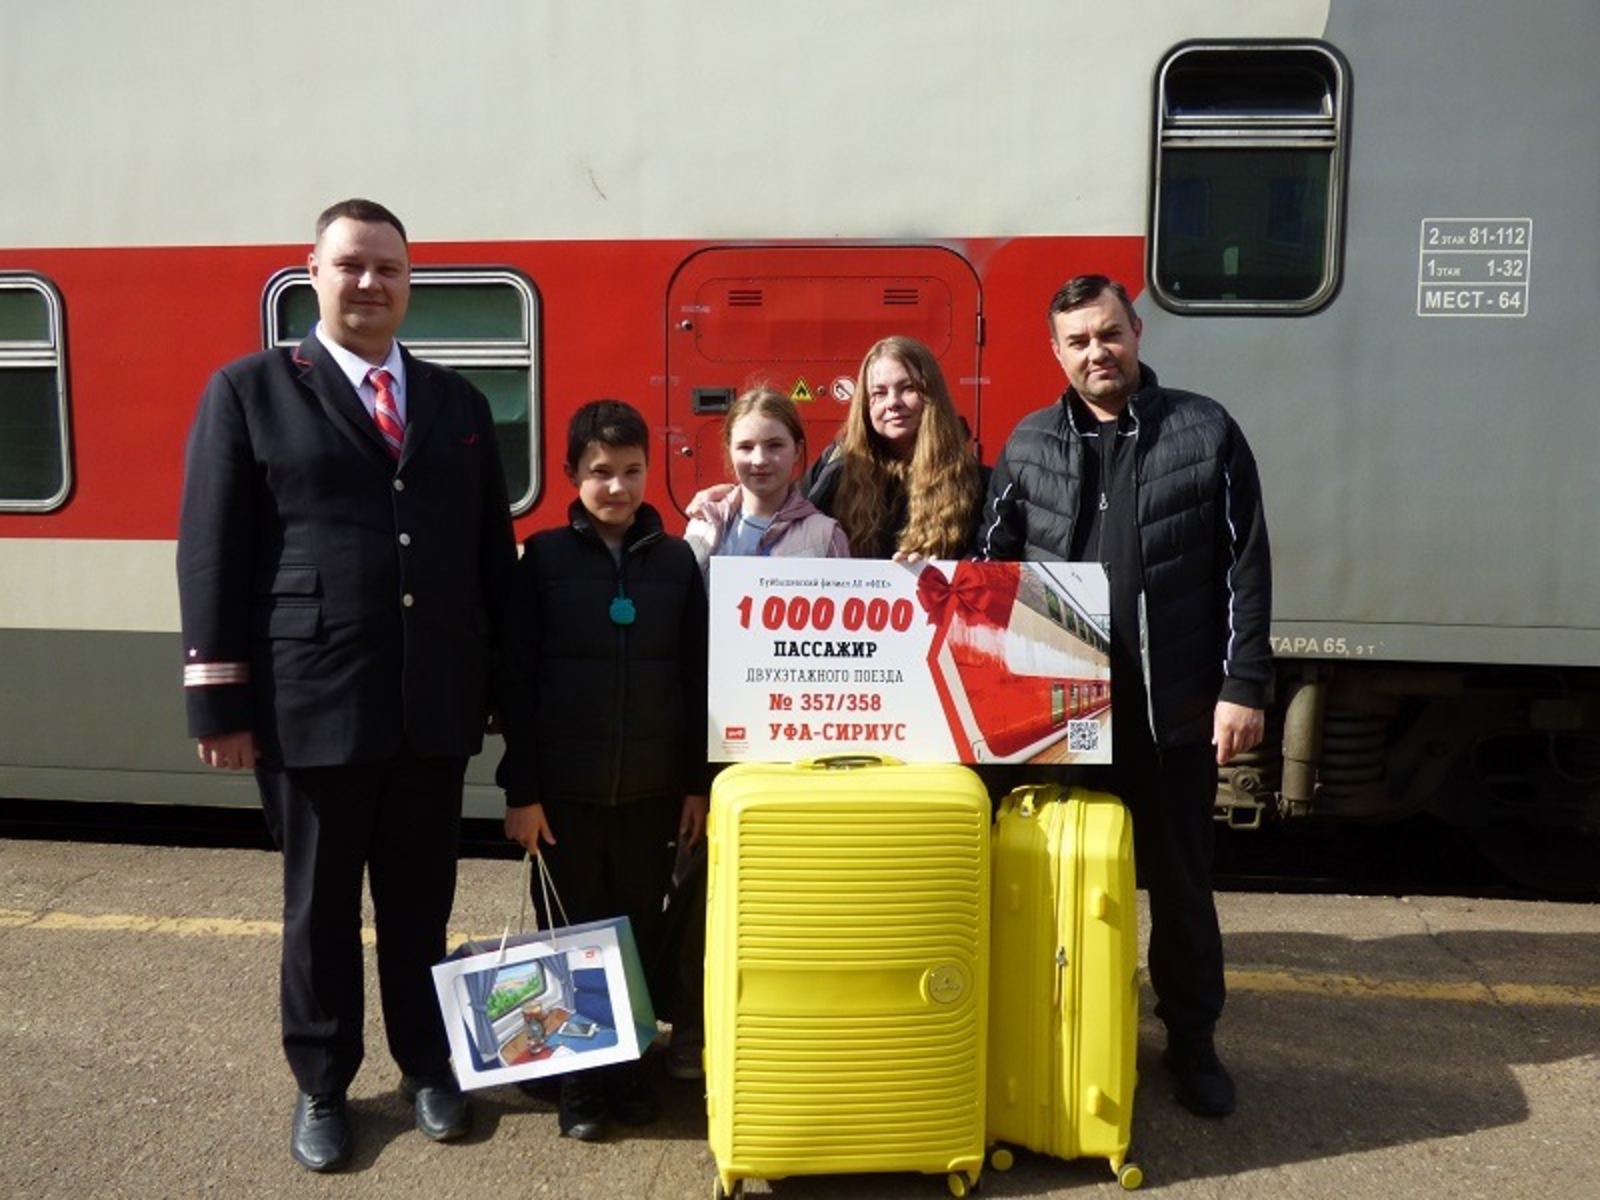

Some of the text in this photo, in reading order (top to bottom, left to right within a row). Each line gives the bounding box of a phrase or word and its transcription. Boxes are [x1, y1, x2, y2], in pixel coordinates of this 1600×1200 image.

[1429, 227, 1439, 245] 2
[1469, 227, 1525, 245] 81-112
[1427, 259, 1435, 276] 1
[1487, 259, 1523, 277] 1-32
[1425, 291, 1484, 309] МЕСТ
[1499, 291, 1521, 309] 64
[737, 595, 914, 632] 1 000 000
[774, 641, 878, 658] ПАССАЖИР
[746, 668, 904, 684] ДВУХЭТАЖНОГО ПОЕЗДА
[769, 693, 882, 711] № 357/358
[769, 723, 906, 741] УФА-СИРИУС
